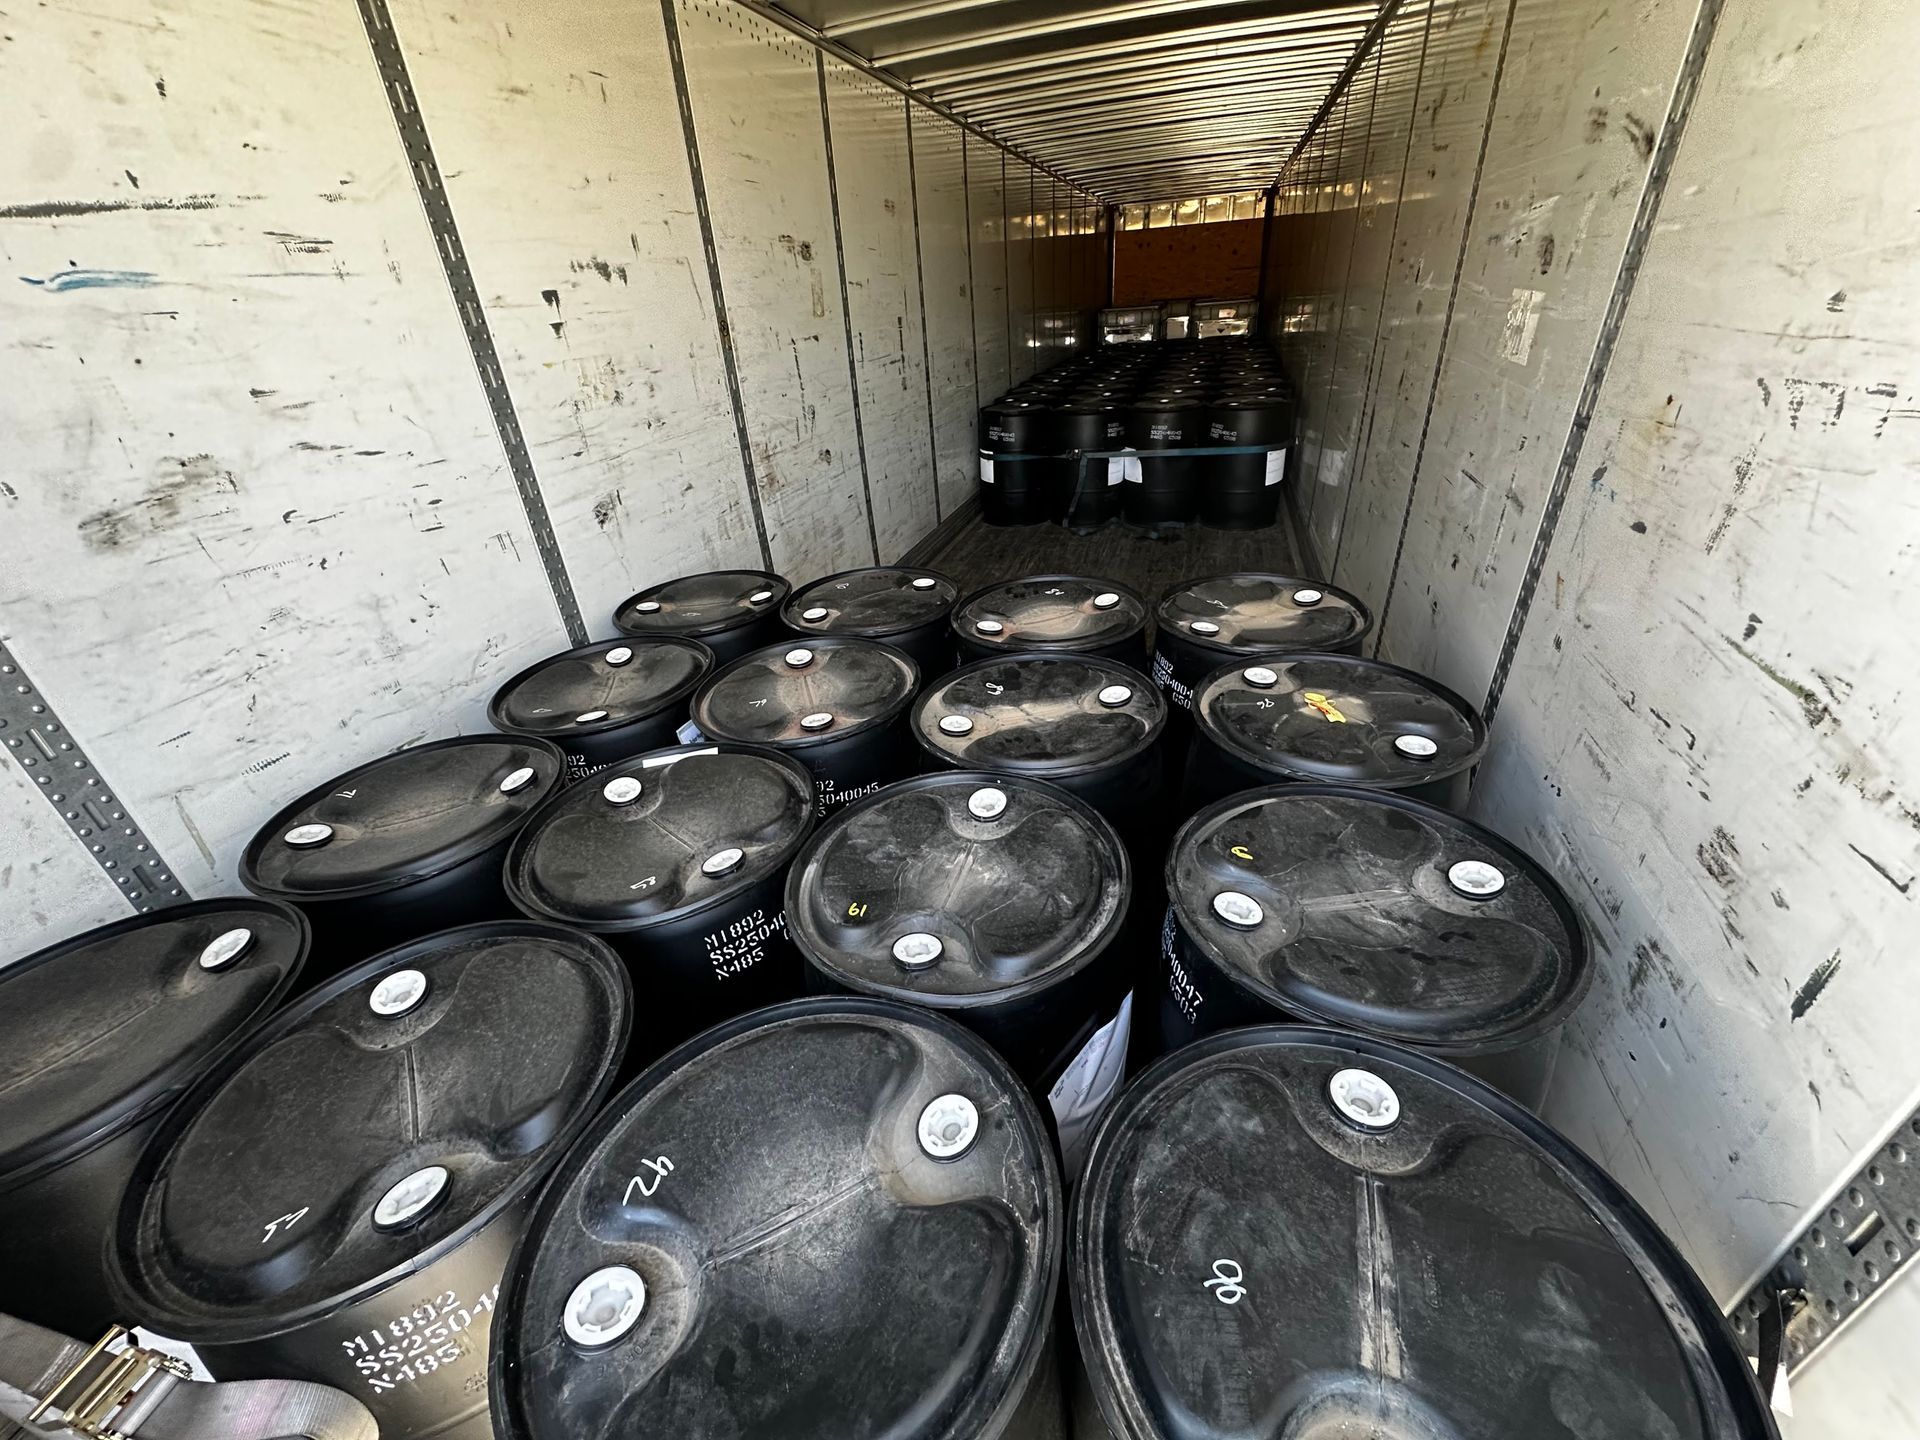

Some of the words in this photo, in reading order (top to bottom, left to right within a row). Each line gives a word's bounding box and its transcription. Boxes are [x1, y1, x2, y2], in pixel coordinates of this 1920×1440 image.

[1172, 691, 1191, 710] C50
[704, 909, 765, 950] M1892
[710, 910, 787, 965] SS25040
[342, 1291, 461, 1357] M1892
[355, 1284, 500, 1375] SS2504
